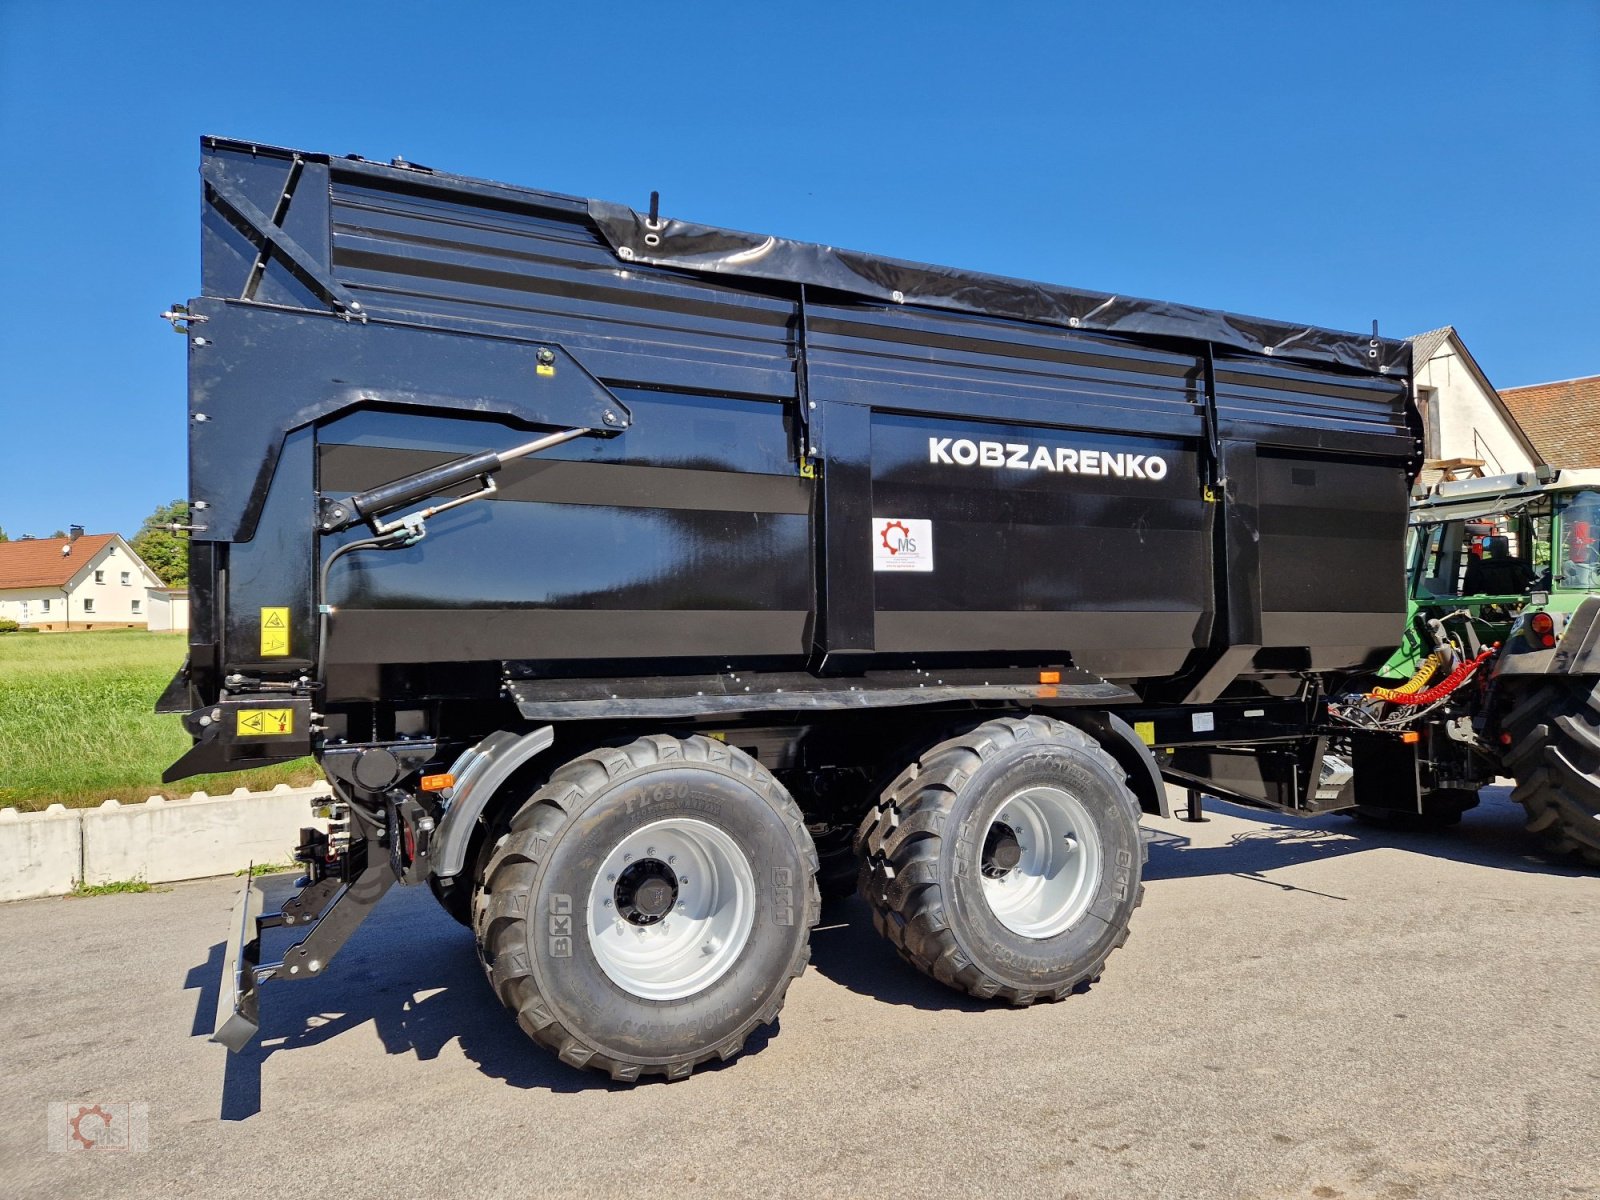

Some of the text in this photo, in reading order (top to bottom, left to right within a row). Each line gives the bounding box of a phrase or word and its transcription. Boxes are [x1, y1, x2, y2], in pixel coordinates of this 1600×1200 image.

[928, 437, 1168, 481] KOBZARENKO
[898, 538, 917, 553] MS
[652, 782, 689, 802] 630
[773, 868, 792, 925] BKT
[1112, 850, 1131, 901] BKT
[552, 895, 571, 957] BKT
